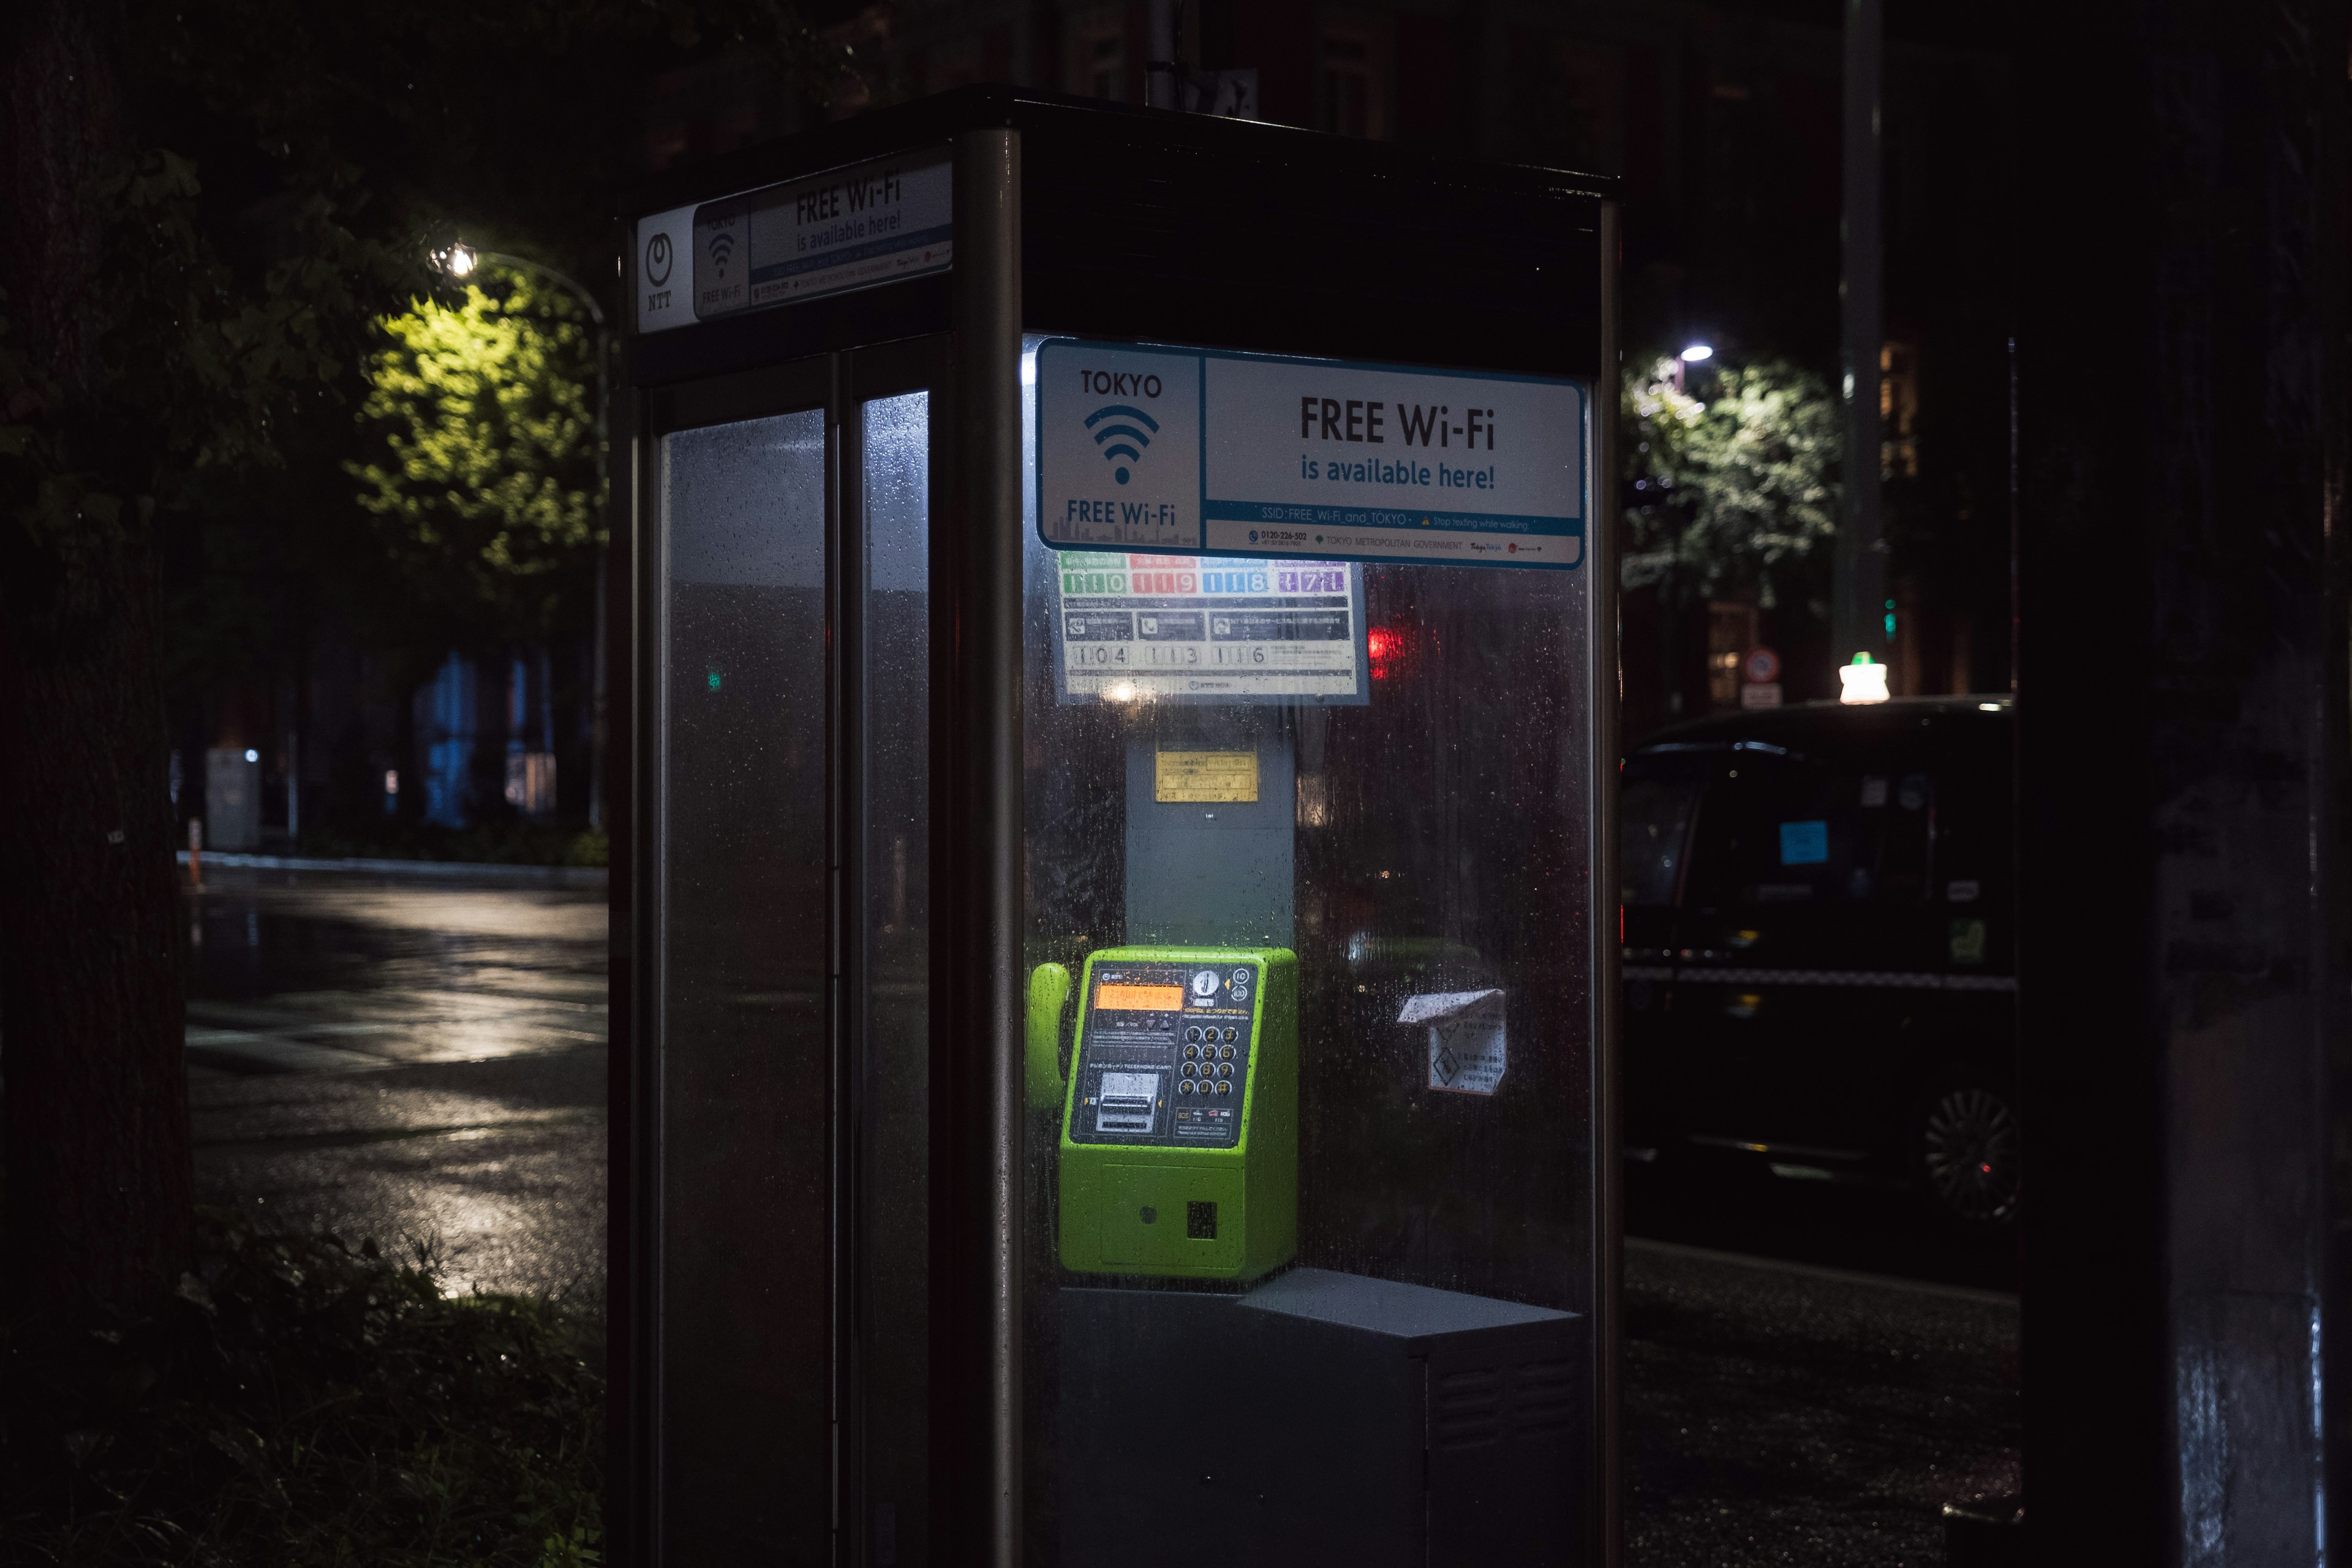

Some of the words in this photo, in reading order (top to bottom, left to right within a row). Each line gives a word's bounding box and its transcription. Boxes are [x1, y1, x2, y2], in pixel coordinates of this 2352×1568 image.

[797, 185, 839, 225] FREE
[846, 167, 900, 213] Wi-Fi
[707, 215, 735, 231] TOKYO
[797, 233, 807, 252] is
[810, 220, 864, 249] available
[869, 209, 900, 235] here!
[648, 290, 671, 311] NTT
[703, 289, 719, 304] FREE
[721, 284, 741, 301] Wi-Fi
[1080, 370, 1162, 398] TOKYO
[1302, 396, 1384, 443] FREE
[1397, 404, 1494, 450] Wi-Fi
[1302, 454, 1319, 479] is
[1327, 458, 1431, 486] available
[1439, 462, 1494, 489] here!
[1068, 499, 1115, 523] FREE
[1121, 502, 1175, 526] Wi-Fi
[1433, 516, 1450, 527] Stop
[1453, 518, 1478, 529] texting
[1479, 519, 1499, 529] while
[1261, 530, 1307, 540] 0120-226-502
[1327, 536, 1352, 545] TOKYO
[1355, 538, 1411, 548] METROPOLITAN
[1414, 540, 1463, 550] GOVERNMENT
[1071, 575, 1123, 592] 110
[1140, 574, 1193, 592] 119
[1210, 574, 1264, 591] 118
[1286, 573, 1338, 590] 171
[1080, 648, 1126, 663] 104
[1152, 648, 1198, 663] 113
[1218, 647, 1264, 663] 116
[1208, 1029, 1214, 1039] 2
[1226, 1030, 1232, 1039] 3
[1186, 1046, 1194, 1057] 4
[1205, 1046, 1212, 1058] 5
[1223, 1047, 1230, 1058] 6
[1186, 1065, 1193, 1074] 7
[1203, 1065, 1210, 1074] 8
[1221, 1065, 1228, 1074] 9
[1201, 1082, 1208, 1092] 0
